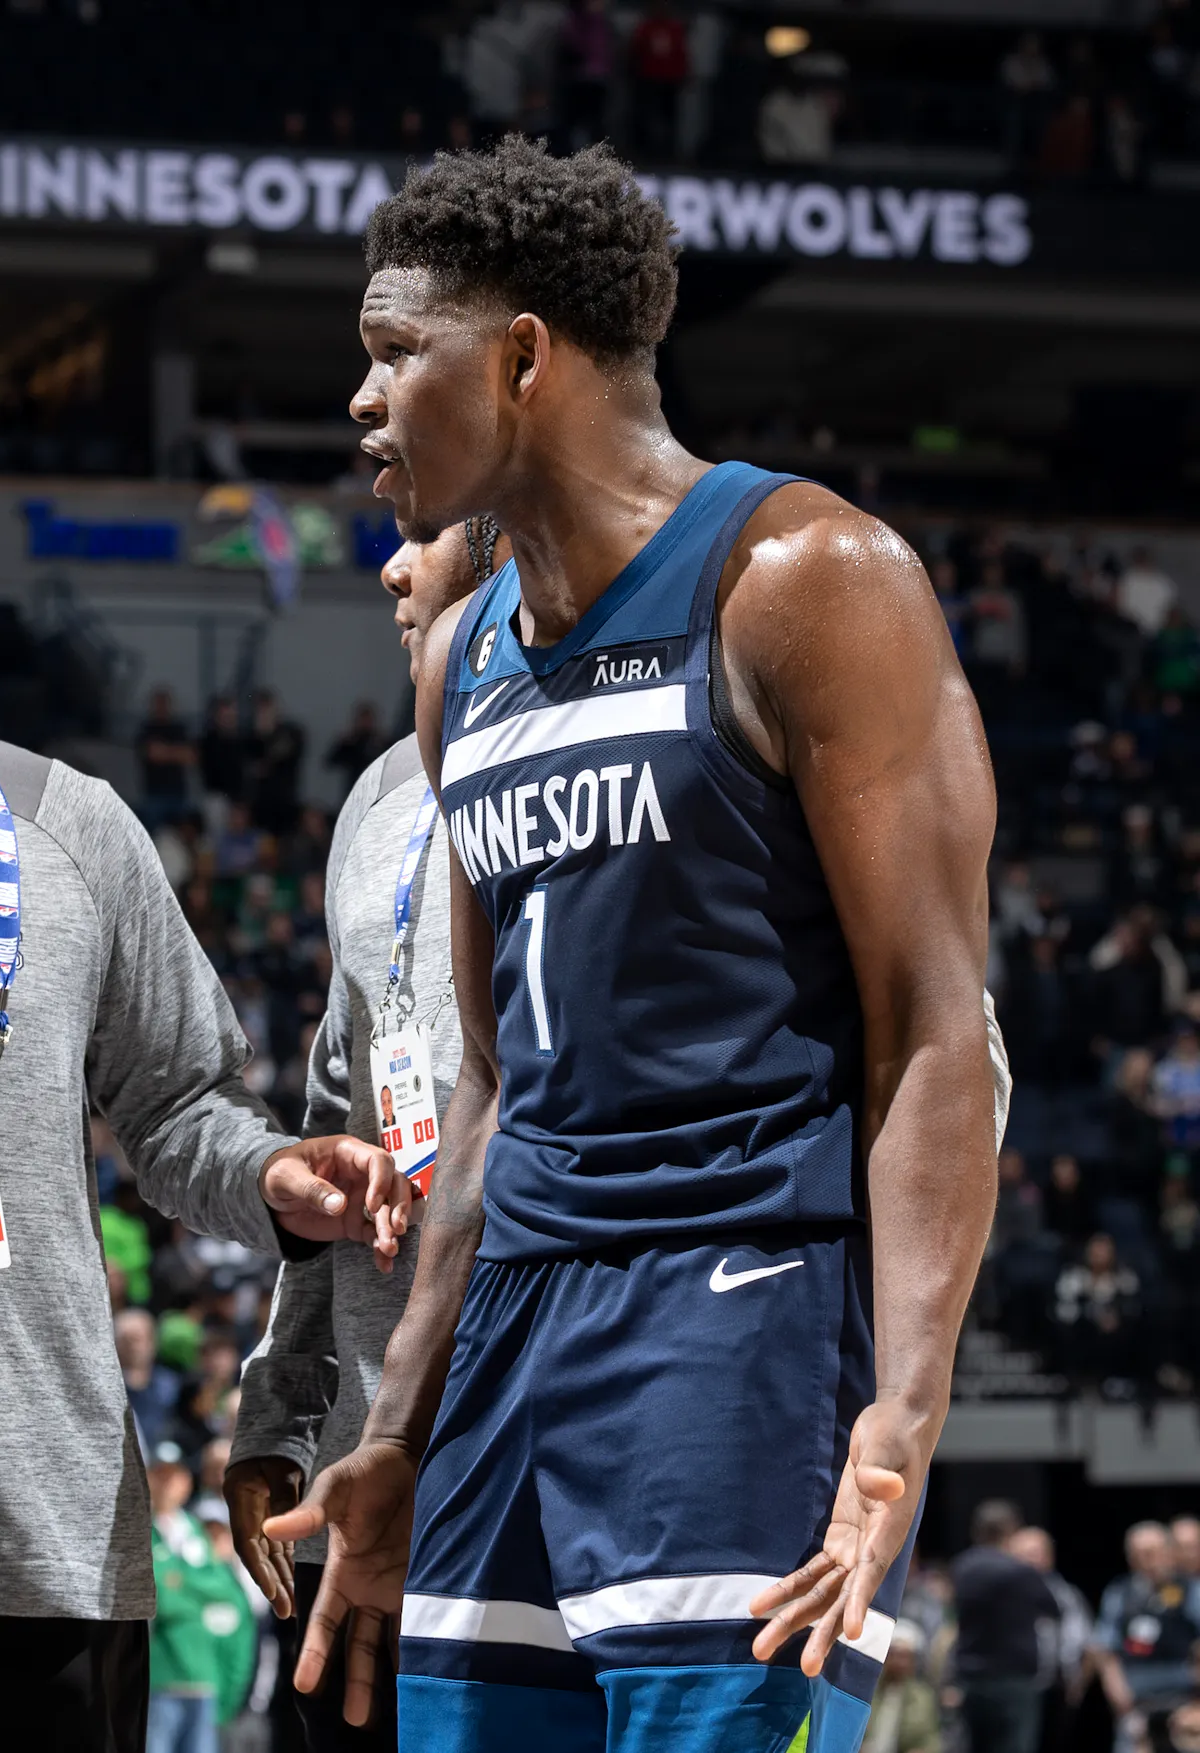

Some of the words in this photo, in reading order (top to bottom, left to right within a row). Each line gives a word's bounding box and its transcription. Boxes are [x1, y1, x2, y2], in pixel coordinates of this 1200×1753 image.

[636, 173, 1031, 266] RWOLVES
[477, 630, 496, 672] 6
[522, 887, 554, 1055] 1
